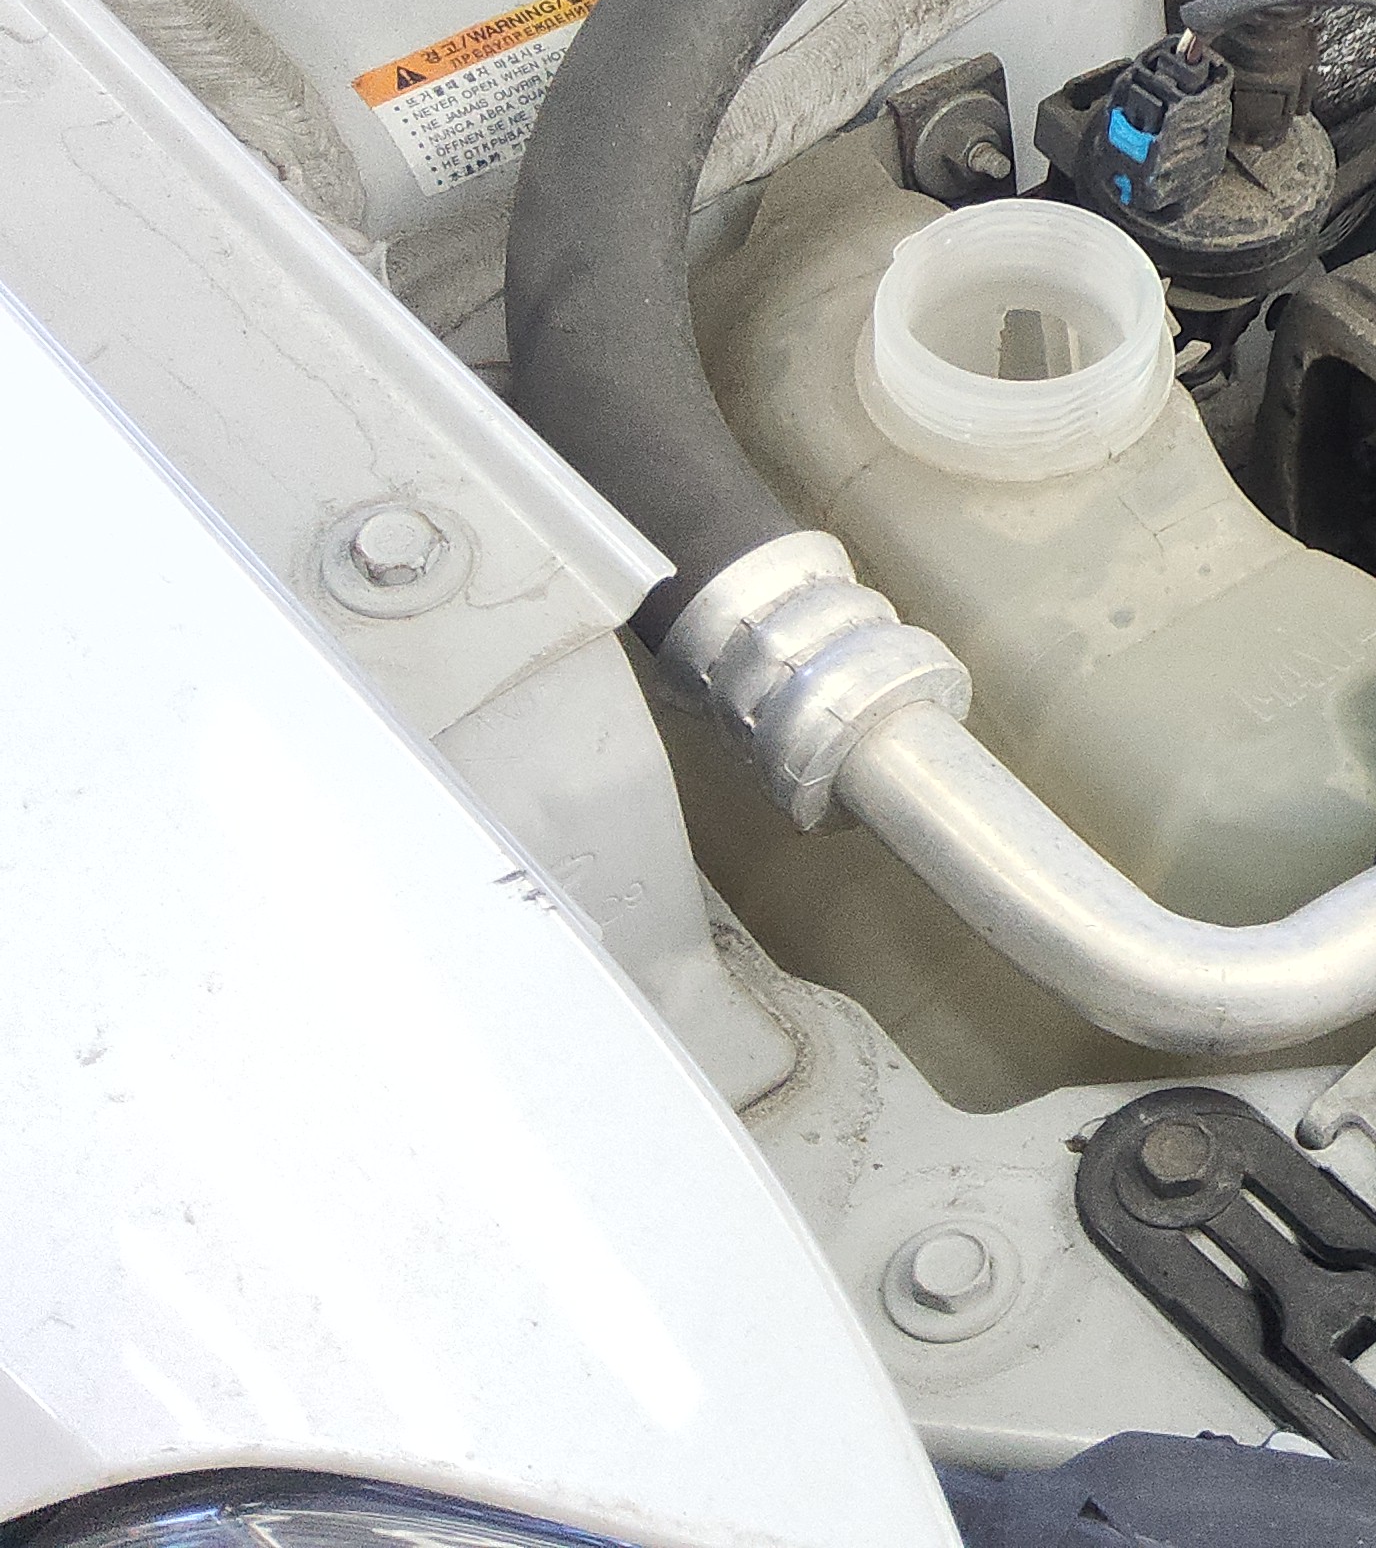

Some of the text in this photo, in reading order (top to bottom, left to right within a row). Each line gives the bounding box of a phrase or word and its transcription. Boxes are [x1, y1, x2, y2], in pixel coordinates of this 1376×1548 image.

[412, 96, 459, 121] NEVER
[461, 78, 499, 99] OPEN
[500, 60, 541, 82] WHEN
[420, 118, 443, 133] NE
[446, 98, 490, 124] JAMAIS
[493, 74, 543, 101] OUVRIR
[428, 119, 475, 144] NUNCA
[479, 100, 516, 124] ABRA
[486, 118, 506, 135] SIE
[441, 154, 461, 170] НЕ
[463, 123, 535, 161] ОТКРЫВАТ
